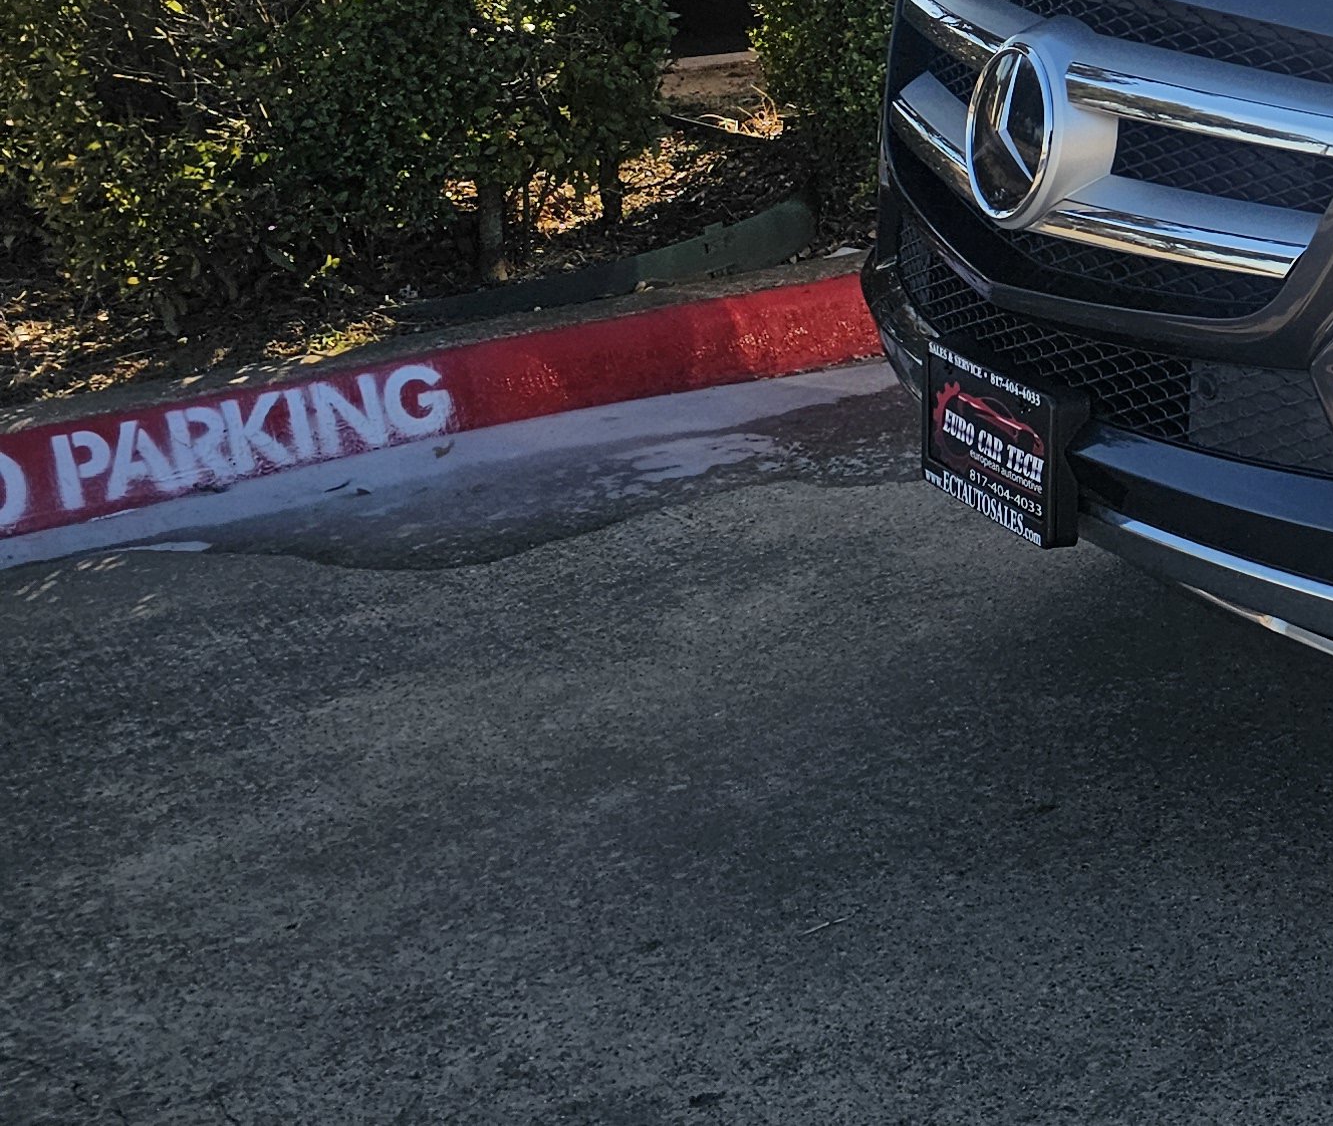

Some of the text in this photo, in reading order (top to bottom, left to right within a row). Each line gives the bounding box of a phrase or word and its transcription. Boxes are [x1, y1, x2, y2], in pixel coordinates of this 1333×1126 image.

[928, 341, 1041, 407] SALES & SERVICE 817-404-4033
[50, 362, 452, 512] PARKING
[943, 409, 1044, 483] EURO CAR TECH
[969, 449, 1043, 495] european automotive
[924, 468, 1042, 548] www.ECTAUTOSALES.com
[969, 469, 1043, 517] 817-404-4033
